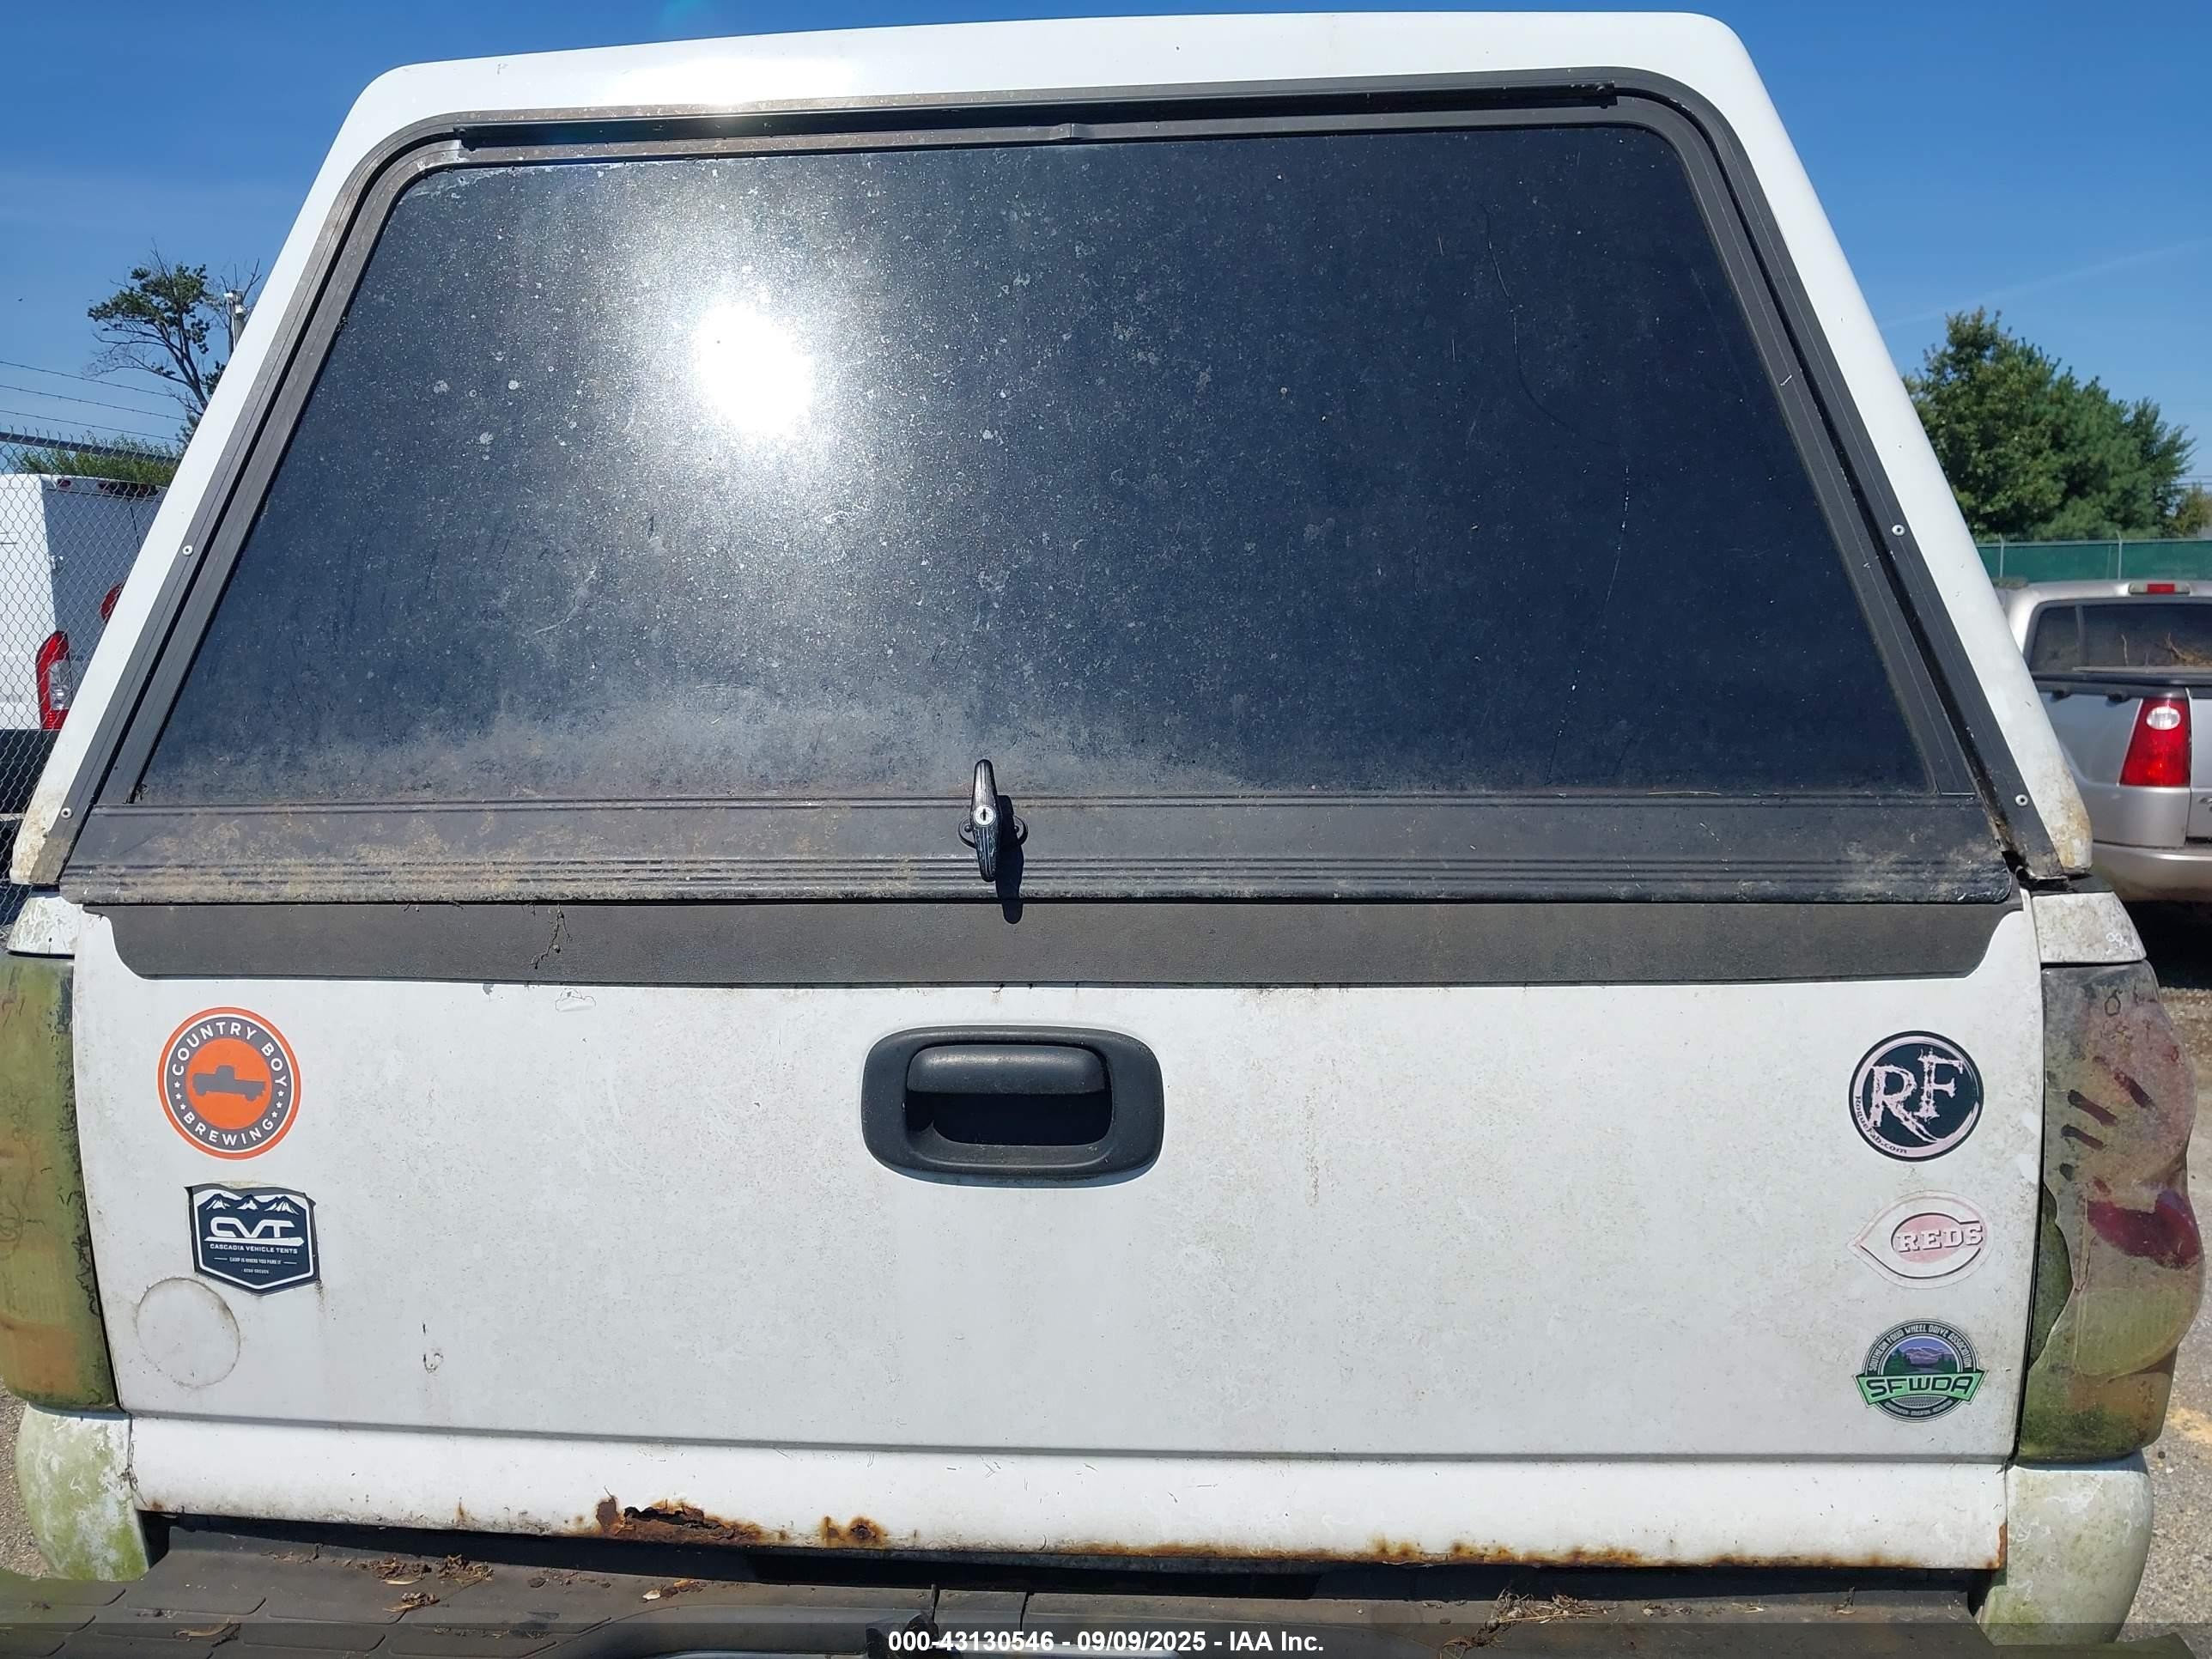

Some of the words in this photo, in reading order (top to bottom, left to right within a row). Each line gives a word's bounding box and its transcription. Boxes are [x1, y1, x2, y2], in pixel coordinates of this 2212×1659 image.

[172, 1022, 257, 1076] COUNTRY
[261, 1042, 288, 1087] BOY
[184, 1112, 273, 1146] BREWING
[210, 1217, 295, 1237] CVT
[1894, 1224, 1983, 1253] REDS
[1905, 1324, 1927, 1334] WHEEL
[1929, 1325, 1949, 1336] DRIVE
[1948, 1333, 1972, 1368] ASSOCIATION
[1866, 1376, 1973, 1398] SFWDA
